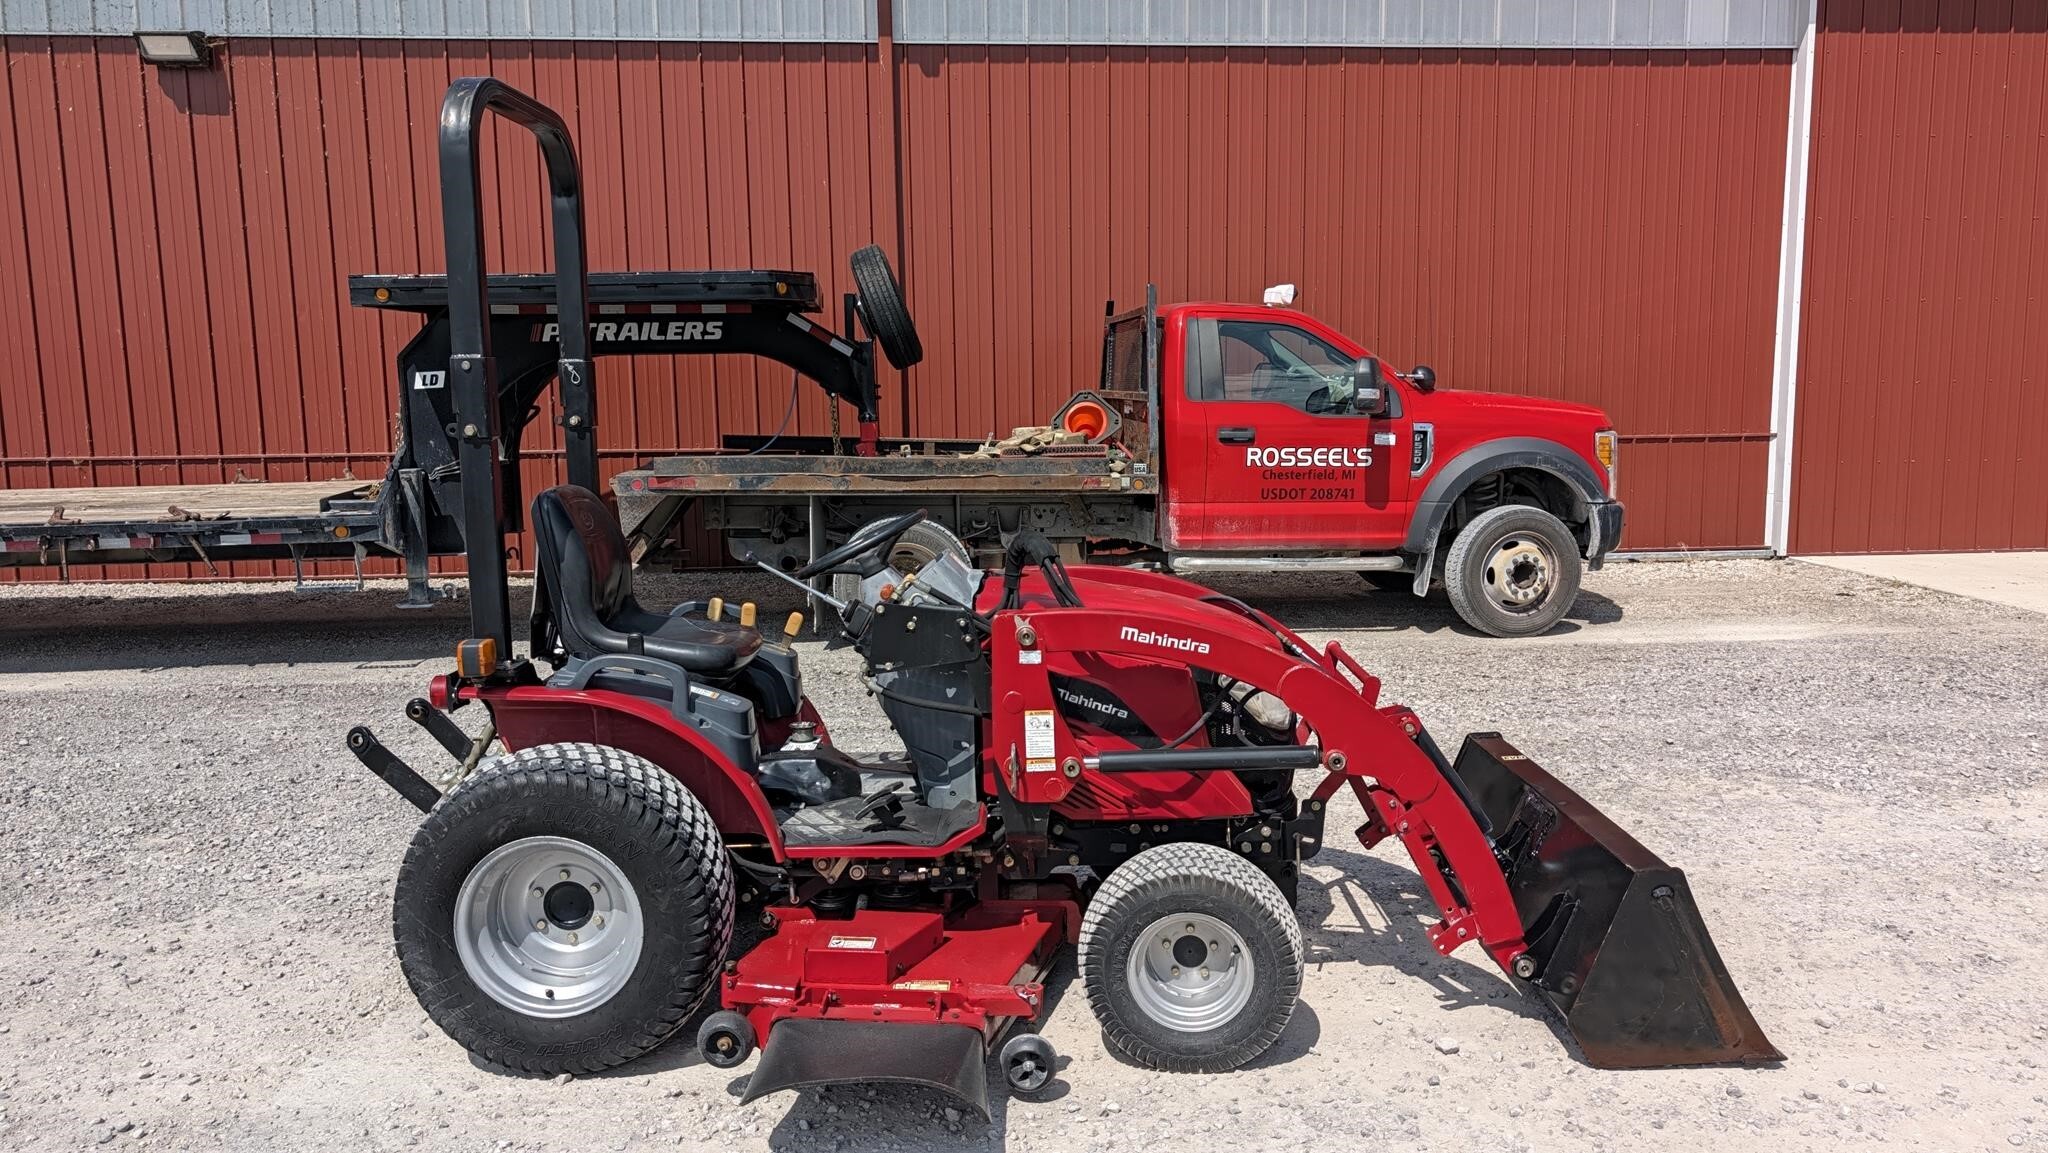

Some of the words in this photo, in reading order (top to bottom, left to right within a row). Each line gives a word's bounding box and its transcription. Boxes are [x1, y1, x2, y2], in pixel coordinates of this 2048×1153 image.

[542, 323, 560, 342] P
[422, 374, 439, 386] LD
[1246, 447, 1373, 467] ROSSEEL'S
[1262, 469, 1338, 481] Chesterfield,
[1341, 470, 1356, 480] MI
[1261, 488, 1306, 500] USDOT
[1310, 488, 1355, 500] 208741
[1120, 626, 1210, 654] Mahindra
[543, 804, 648, 860] TITAN
[536, 1022, 623, 1057] MULTI
